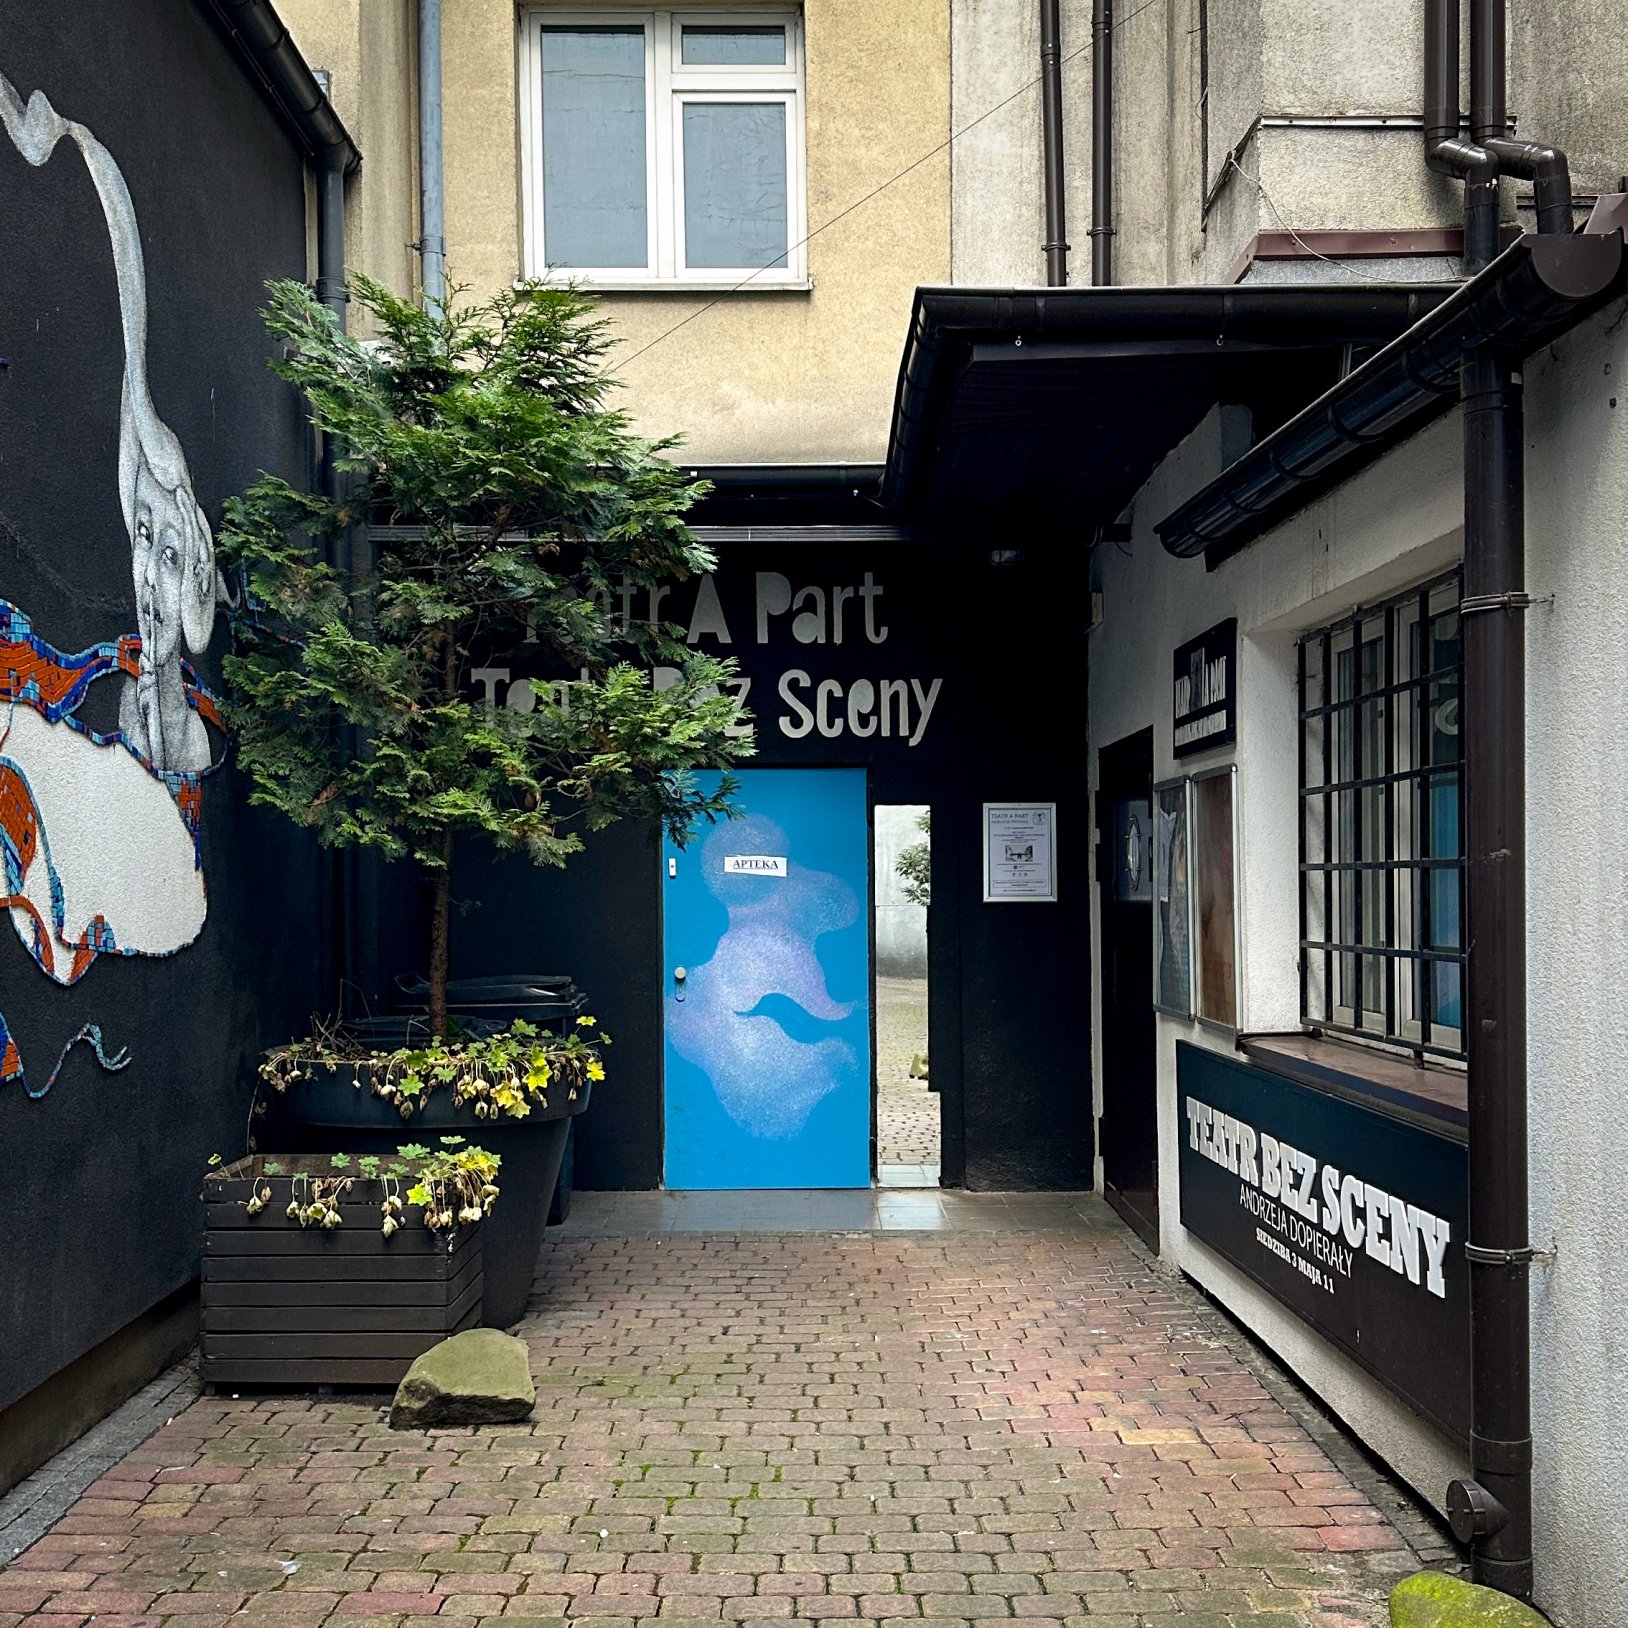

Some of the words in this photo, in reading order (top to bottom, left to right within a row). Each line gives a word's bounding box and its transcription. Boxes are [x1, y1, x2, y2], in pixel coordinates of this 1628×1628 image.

[687, 572, 732, 644] A
[755, 571, 889, 645] Part
[778, 669, 944, 747] Sceny
[732, 859, 779, 870] APTEKA
[1186, 1096, 1259, 1188] TEATR
[1260, 1132, 1319, 1224] BEZ
[1321, 1164, 1450, 1299] SCENY
[1239, 1183, 1289, 1238] ANDRZEJA
[1289, 1214, 1354, 1279] DOPIERAŁY
[1255, 1226, 1292, 1264] SIEDZIBA
[1291, 1251, 1298, 1268] 3
[1297, 1255, 1323, 1286] MAJA
[1323, 1274, 1335, 1295] 11
